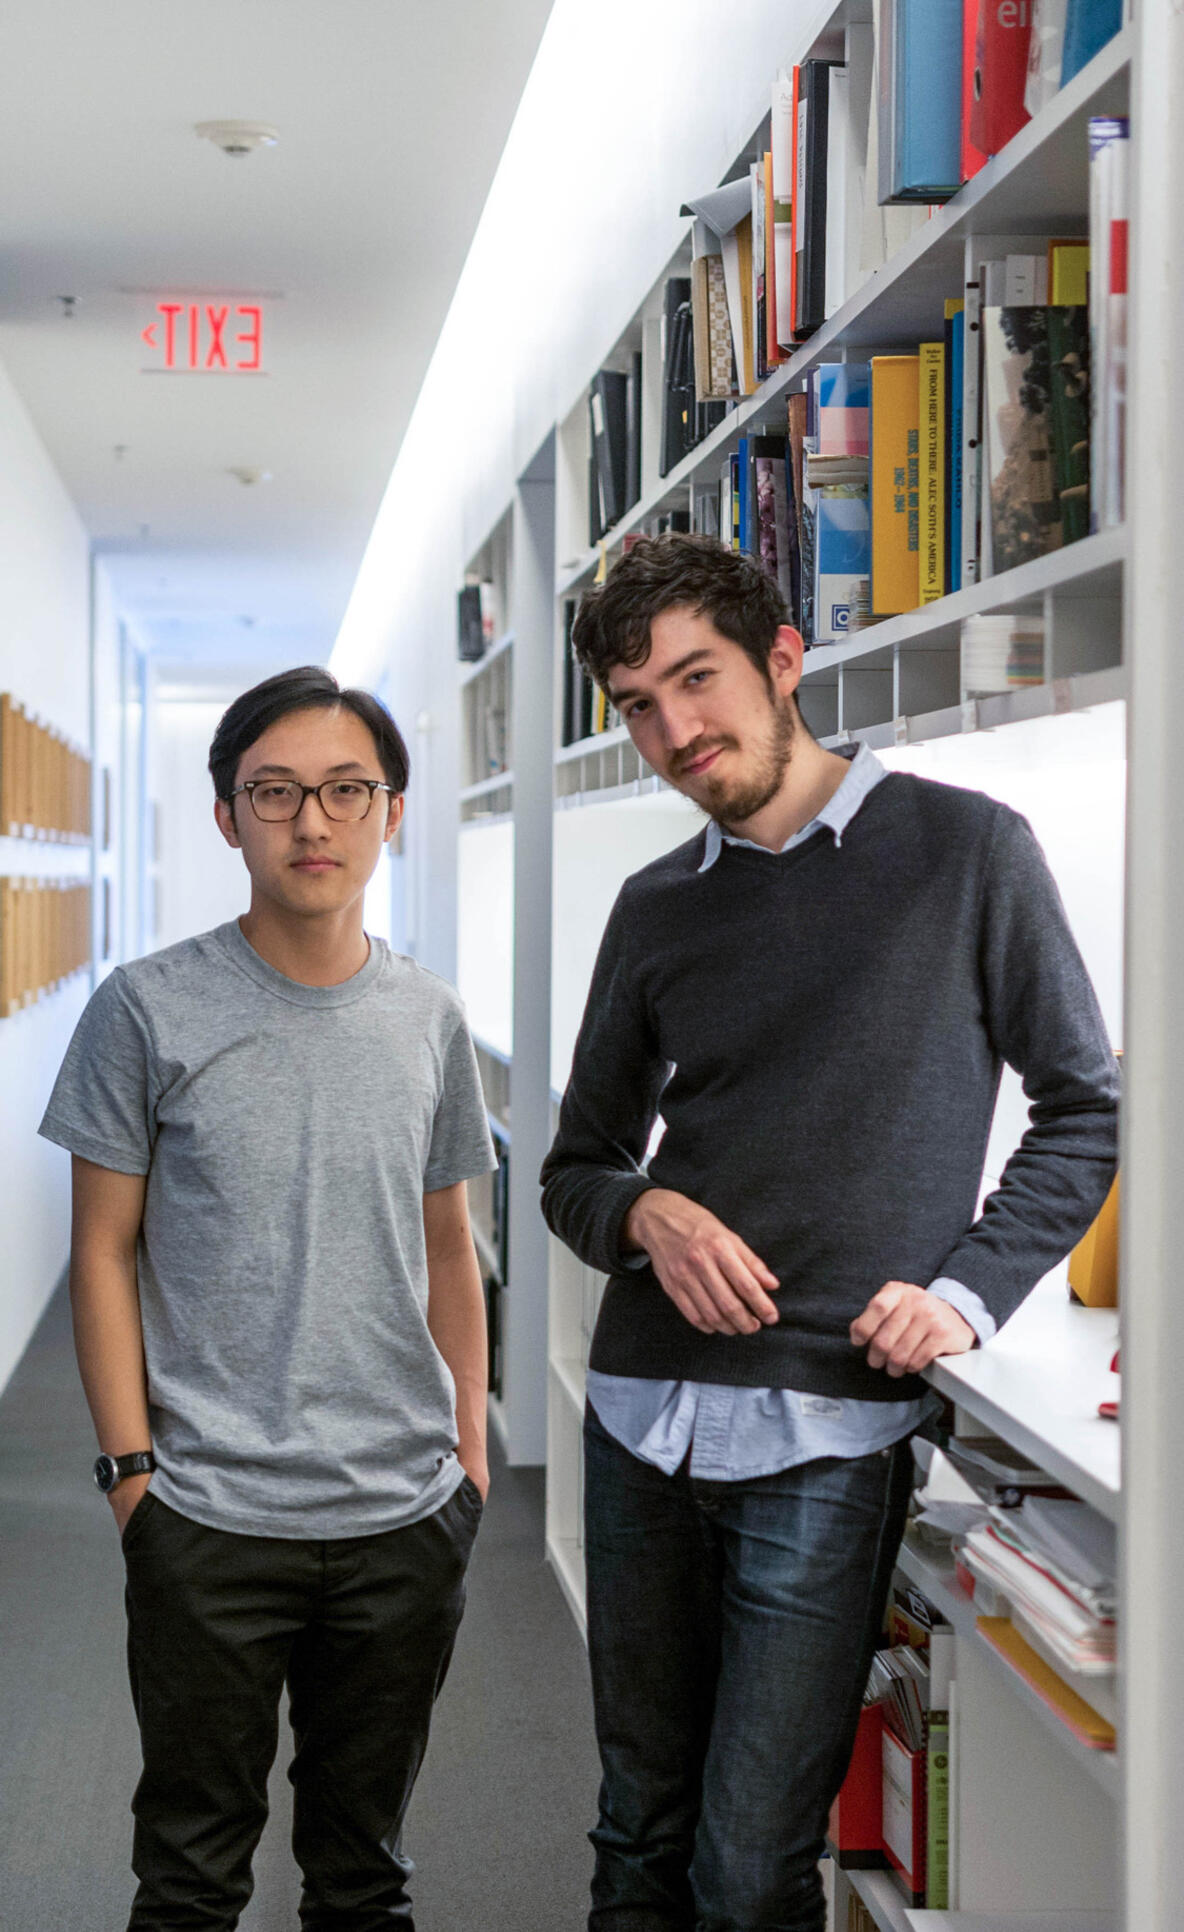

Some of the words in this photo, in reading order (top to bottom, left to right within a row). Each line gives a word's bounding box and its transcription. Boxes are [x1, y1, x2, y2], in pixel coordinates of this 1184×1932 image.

[928, 368, 937, 398] FROM
[928, 399, 937, 424] HERE
[928, 427, 937, 439] TO
[927, 478, 937, 502] ALEC
[927, 540, 937, 585] AMERICA
